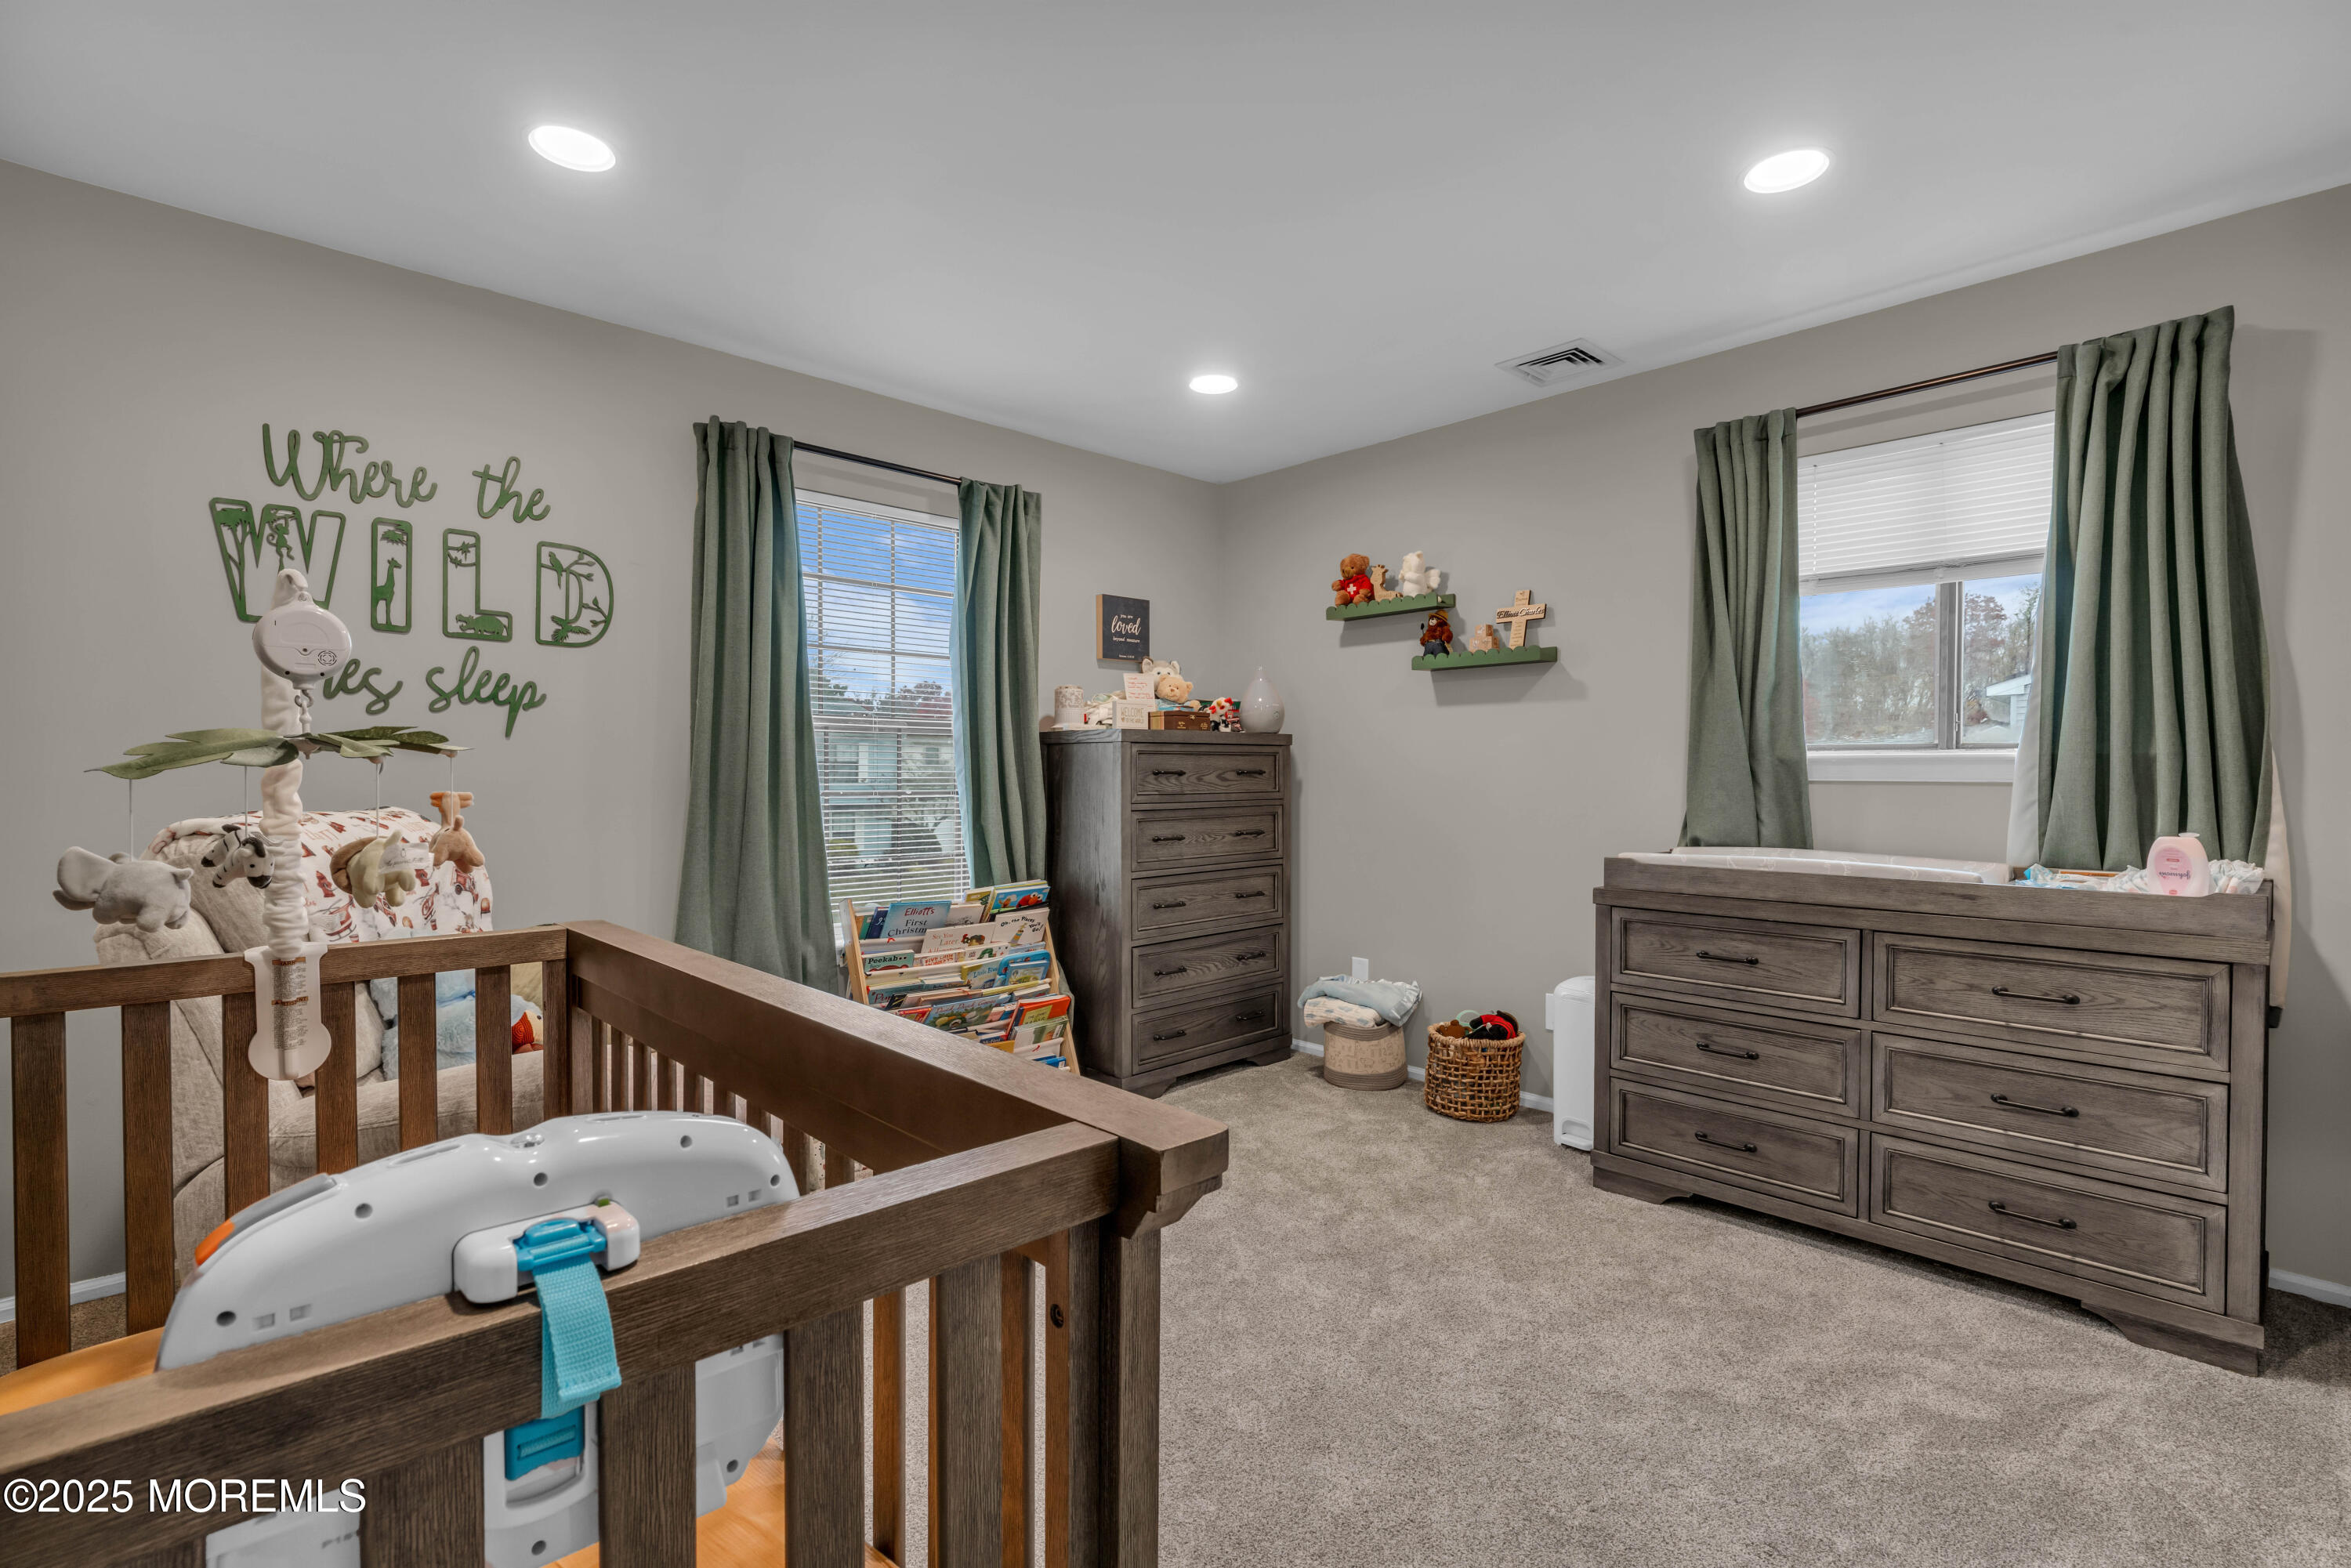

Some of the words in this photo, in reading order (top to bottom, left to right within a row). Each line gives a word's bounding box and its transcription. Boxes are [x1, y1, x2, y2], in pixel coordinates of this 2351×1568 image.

[262, 422, 438, 509] Where
[473, 456, 551, 523] the
[208, 497, 614, 647] WILD
[1111, 615, 1142, 636] loved
[426, 646, 547, 740] sleep
[887, 926, 928, 937] Christm
